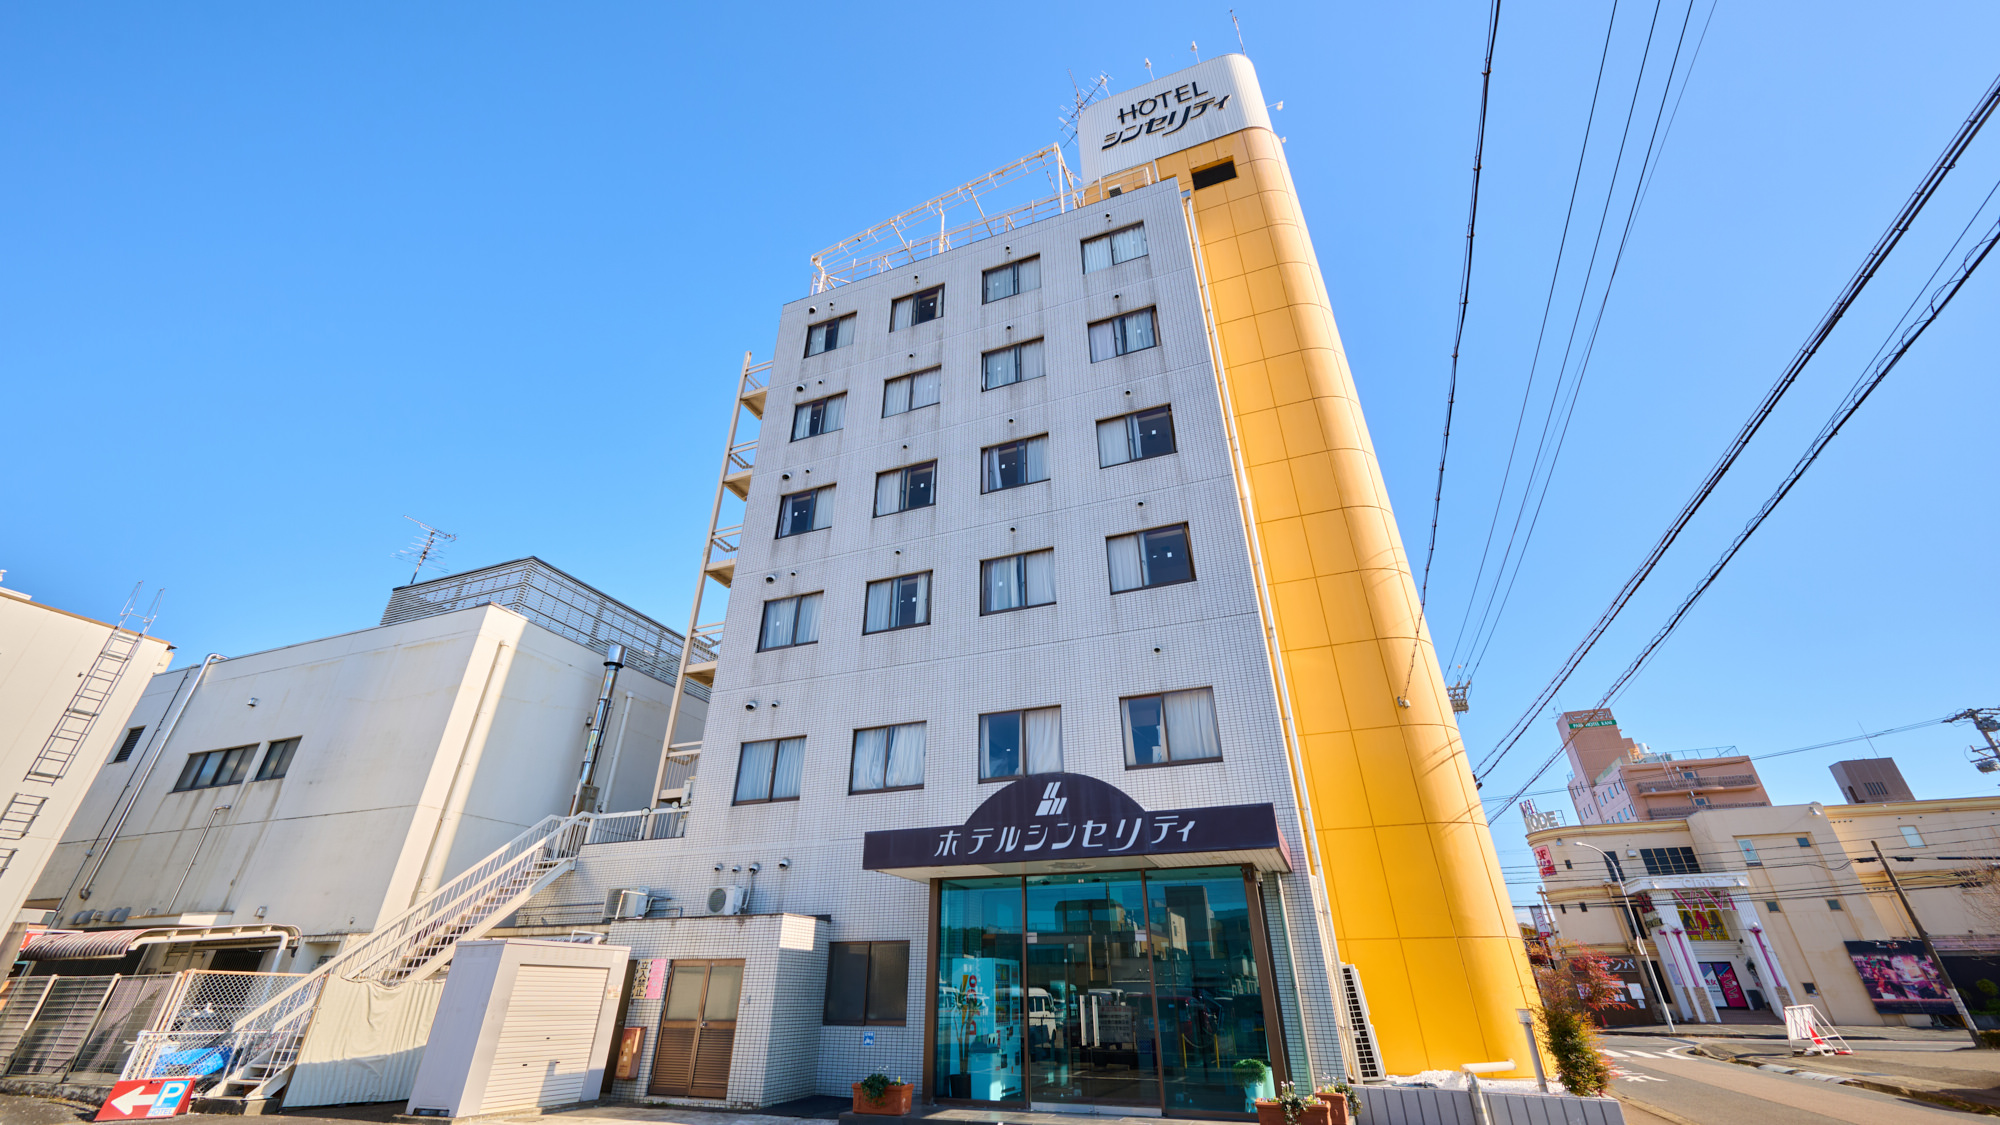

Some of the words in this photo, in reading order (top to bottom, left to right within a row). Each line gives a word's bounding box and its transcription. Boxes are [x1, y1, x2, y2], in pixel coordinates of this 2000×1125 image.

[1117, 81, 1209, 125] HOTEL
[1101, 94, 1232, 150] シンセリティ
[934, 815, 1196, 857] ホテルシンセリティ
[1672, 888, 1737, 912] ViVi
[635, 961, 650, 997] 立入禁止
[148, 1108, 173, 1116] HOTEL
[155, 1082, 186, 1107] P
